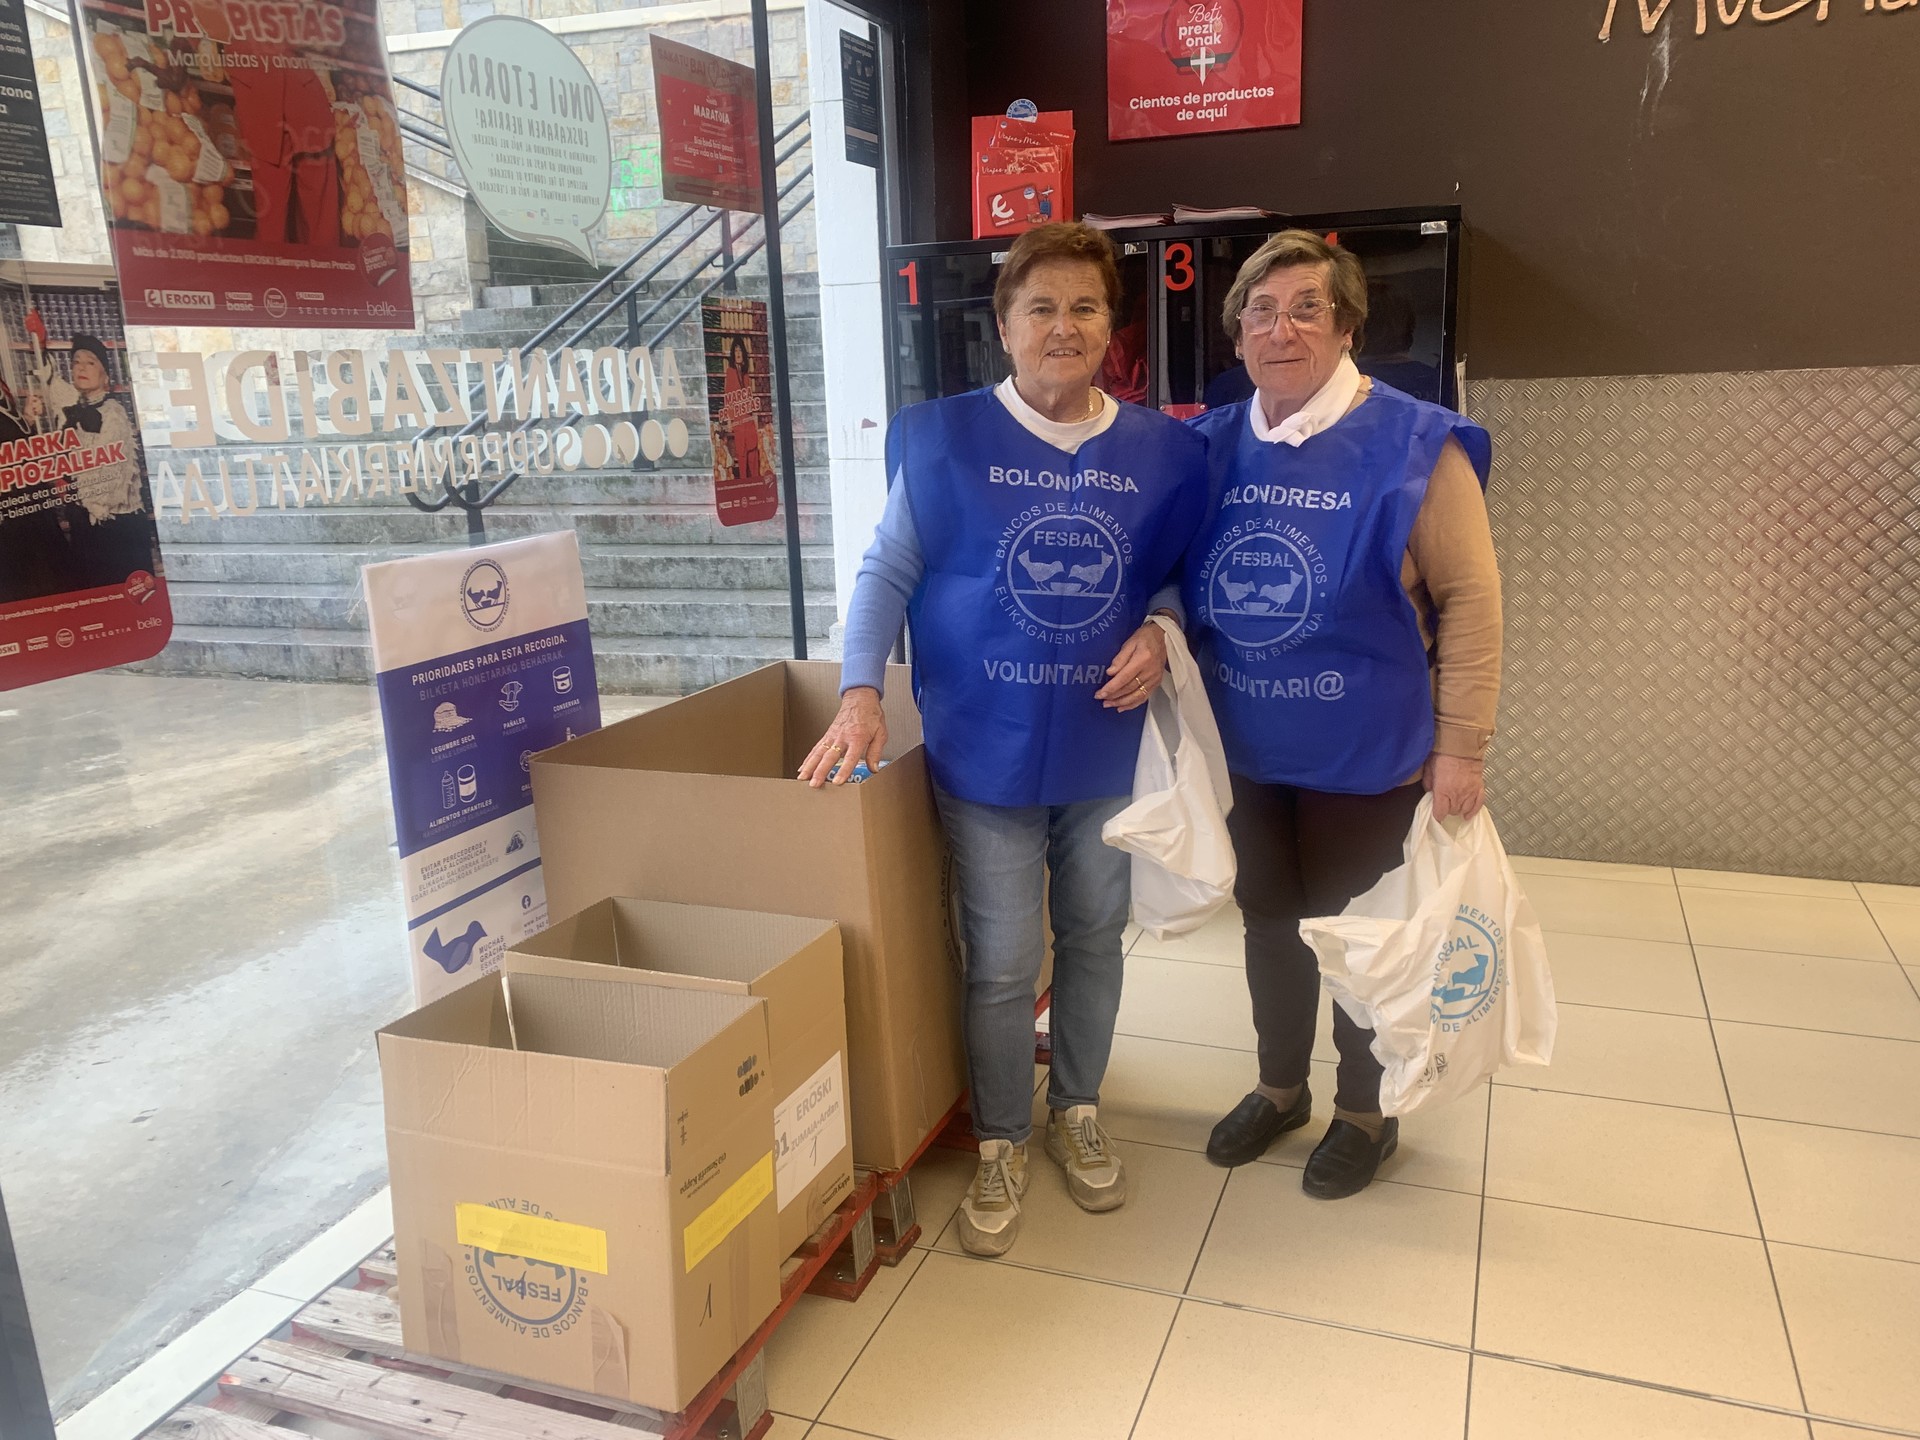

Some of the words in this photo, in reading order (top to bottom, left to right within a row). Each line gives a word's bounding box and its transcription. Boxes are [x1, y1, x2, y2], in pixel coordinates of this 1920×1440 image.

[1188, 2, 1223, 24] Beti
[1186, 32, 1222, 47] onak
[168, 50, 259, 72] Marquistas
[262, 55, 270, 73] y
[1130, 95, 1180, 110] Cientos
[1182, 92, 1200, 105] de
[1203, 86, 1274, 106] productos
[1176, 108, 1194, 121] de
[1196, 104, 1228, 122] aquí
[332, 260, 356, 271] Precio
[1164, 242, 1196, 291] 3
[898, 261, 918, 306] 1
[166, 294, 211, 305] EROSKI
[226, 300, 254, 312] basic
[366, 301, 397, 317] belle
[724, 387, 752, 404] MARCA
[989, 465, 1140, 494] BOLONDRESA
[32, 489, 50, 500] eta
[42, 495, 62, 509] dira
[995, 504, 1042, 559] BANCOS
[1045, 502, 1067, 513] DE
[1070, 501, 1133, 566] ALIMENTOS
[1033, 530, 1104, 549] FESBAL
[1200, 525, 1242, 579] BANCOS
[1245, 517, 1262, 533] DE
[1264, 517, 1328, 585] ALIMENTOS
[1231, 551, 1294, 568] FESBAL
[136, 617, 163, 630] belle
[994, 586, 1075, 645] ELIKAGAIEN
[1079, 592, 1126, 643] BANKUA
[1270, 612, 1324, 658] BANKUA
[411, 659, 475, 686] PRIORIDADES
[476, 651, 500, 668] PARA
[501, 645, 523, 660] ESTA
[524, 633, 568, 654] RECOGIDA.
[419, 681, 460, 701] BILKETA
[462, 663, 518, 688] HONETARAKO
[983, 659, 1106, 686] VOLUNTARI
[502, 716, 526, 730] PAÑALES
[430, 739, 460, 755] LEGUMBRE
[461, 734, 476, 744] SECA
[429, 811, 461, 829] ALIMENTOS
[461, 799, 493, 816] INFANTILES
[420, 860, 441, 875] EVITAR
[442, 843, 482, 864] PERECEDEROS
[418, 874, 446, 892] ELIKAGAI
[481, 853, 491, 863] ETA
[422, 865, 447, 881] BEBIDAS
[411, 889, 429, 903] EDARI
[479, 935, 504, 953] MUCHAS
[479, 942, 507, 963] GRACIAS
[1442, 1022, 1461, 1033] DE
[796, 1076, 832, 1122] EROSKI
[791, 1101, 839, 1152] ZUMAIA-Ardan
[521, 1199, 540, 1216] DE
[491, 1274, 562, 1303] FESBAL
[465, 1264, 527, 1336] ALIMENTOS
[552, 1286, 589, 1336] BANCOS
[532, 1326, 550, 1339] DE
